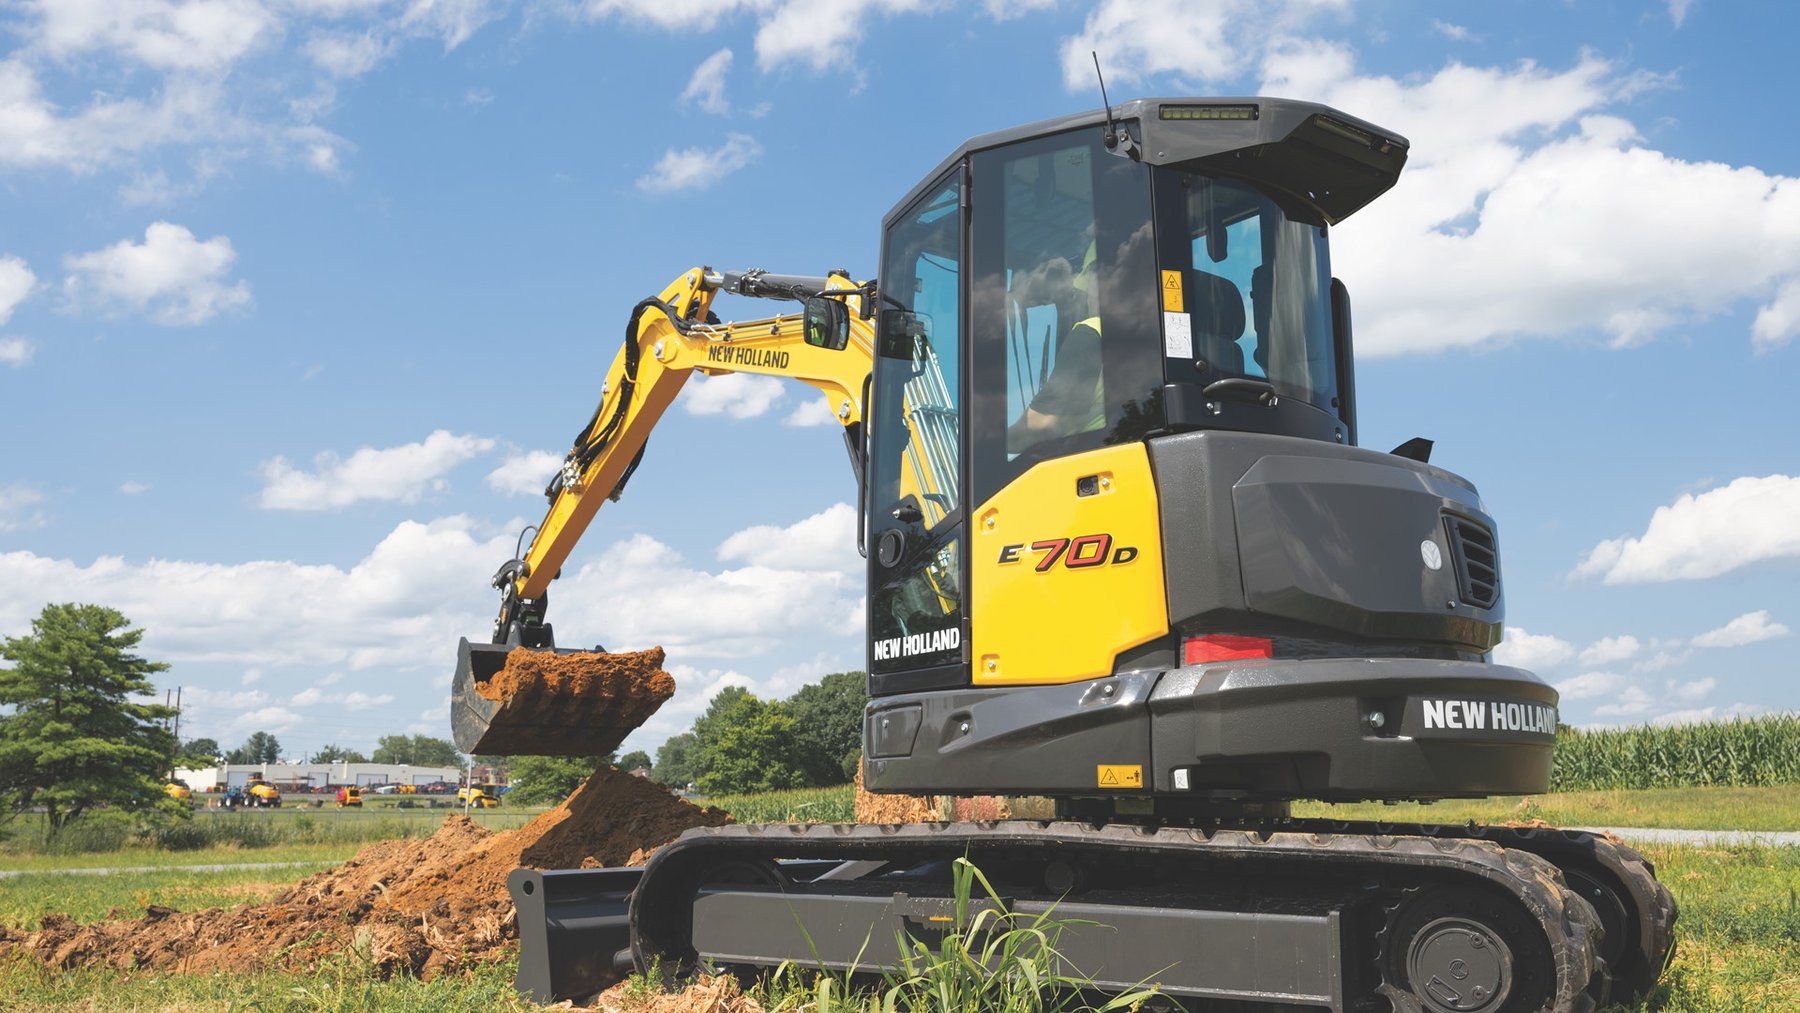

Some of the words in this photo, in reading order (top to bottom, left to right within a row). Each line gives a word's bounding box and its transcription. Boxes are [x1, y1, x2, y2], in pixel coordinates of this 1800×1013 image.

[708, 345, 734, 363] NEW
[735, 347, 789, 369] HOLLAND
[874, 638, 901, 661] NEW
[903, 627, 960, 656] HOLLAND
[1423, 700, 1485, 729] NEW
[1491, 702, 1556, 735] HOLLAND
